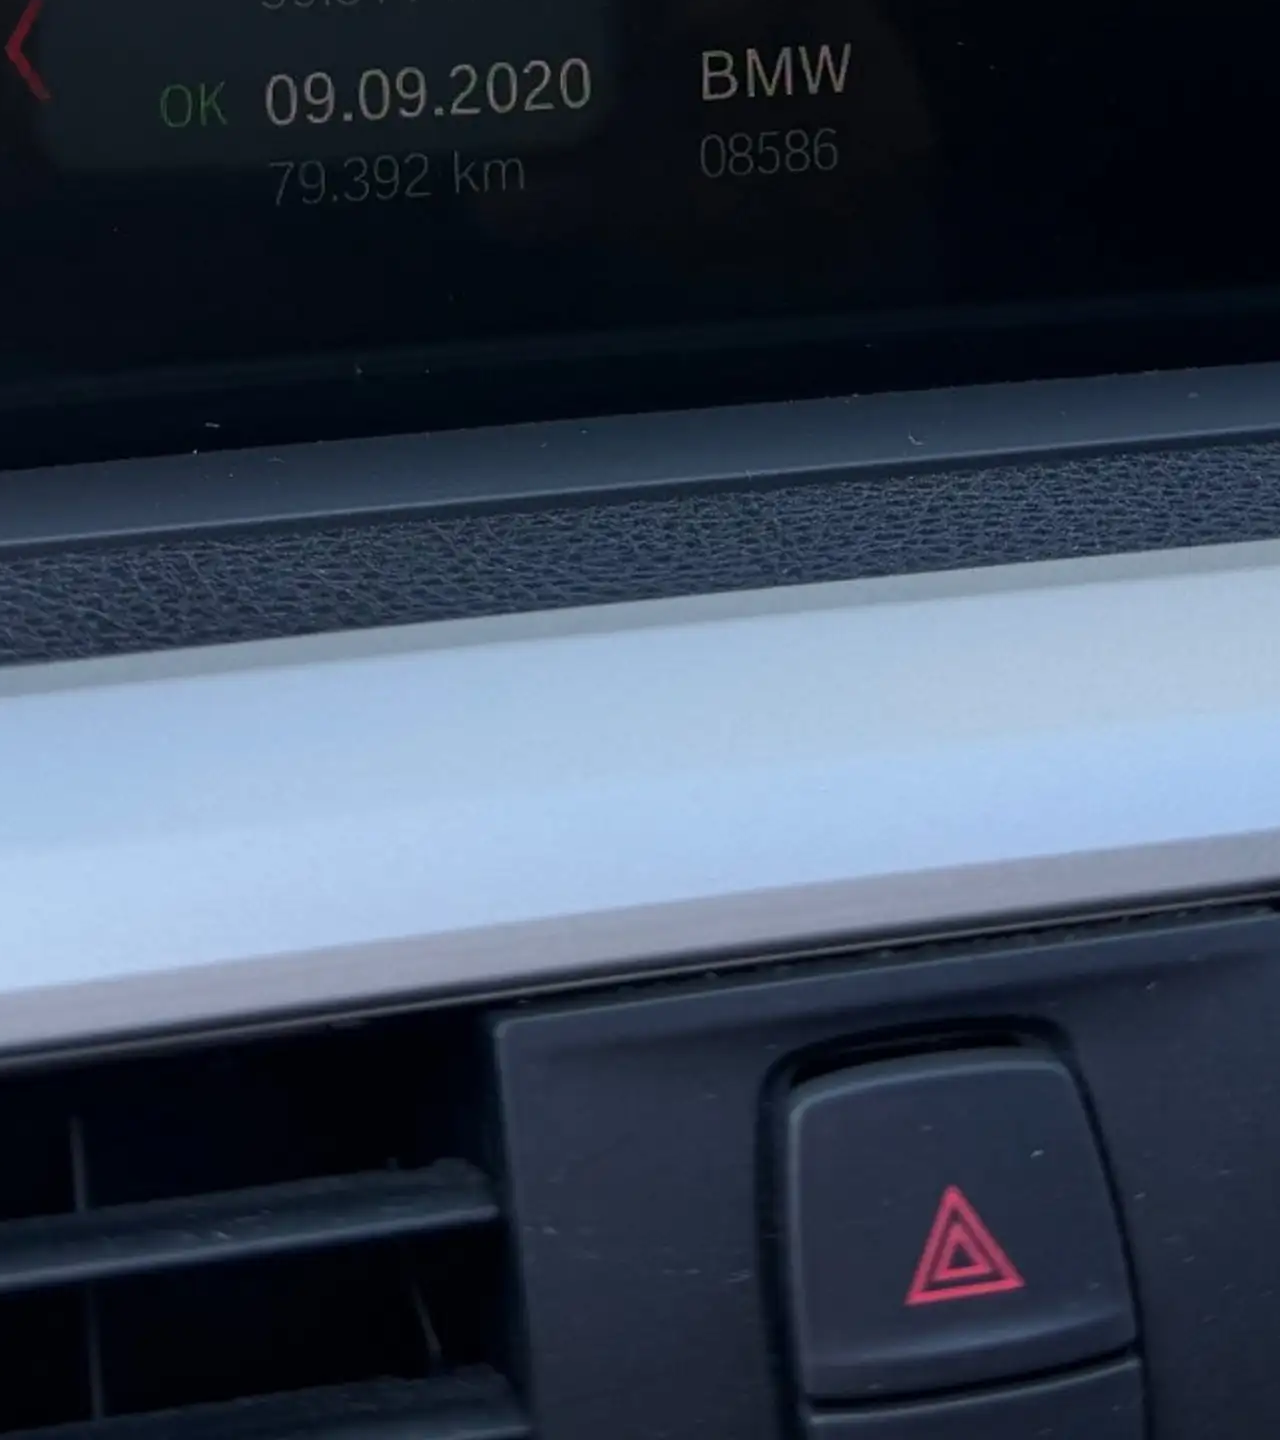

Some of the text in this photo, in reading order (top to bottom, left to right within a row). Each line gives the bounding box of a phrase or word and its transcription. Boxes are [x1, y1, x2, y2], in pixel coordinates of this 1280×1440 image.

[159, 41, 852, 129] OK 09.09.2020 BMW
[267, 126, 839, 208] 79.392 km 08586
